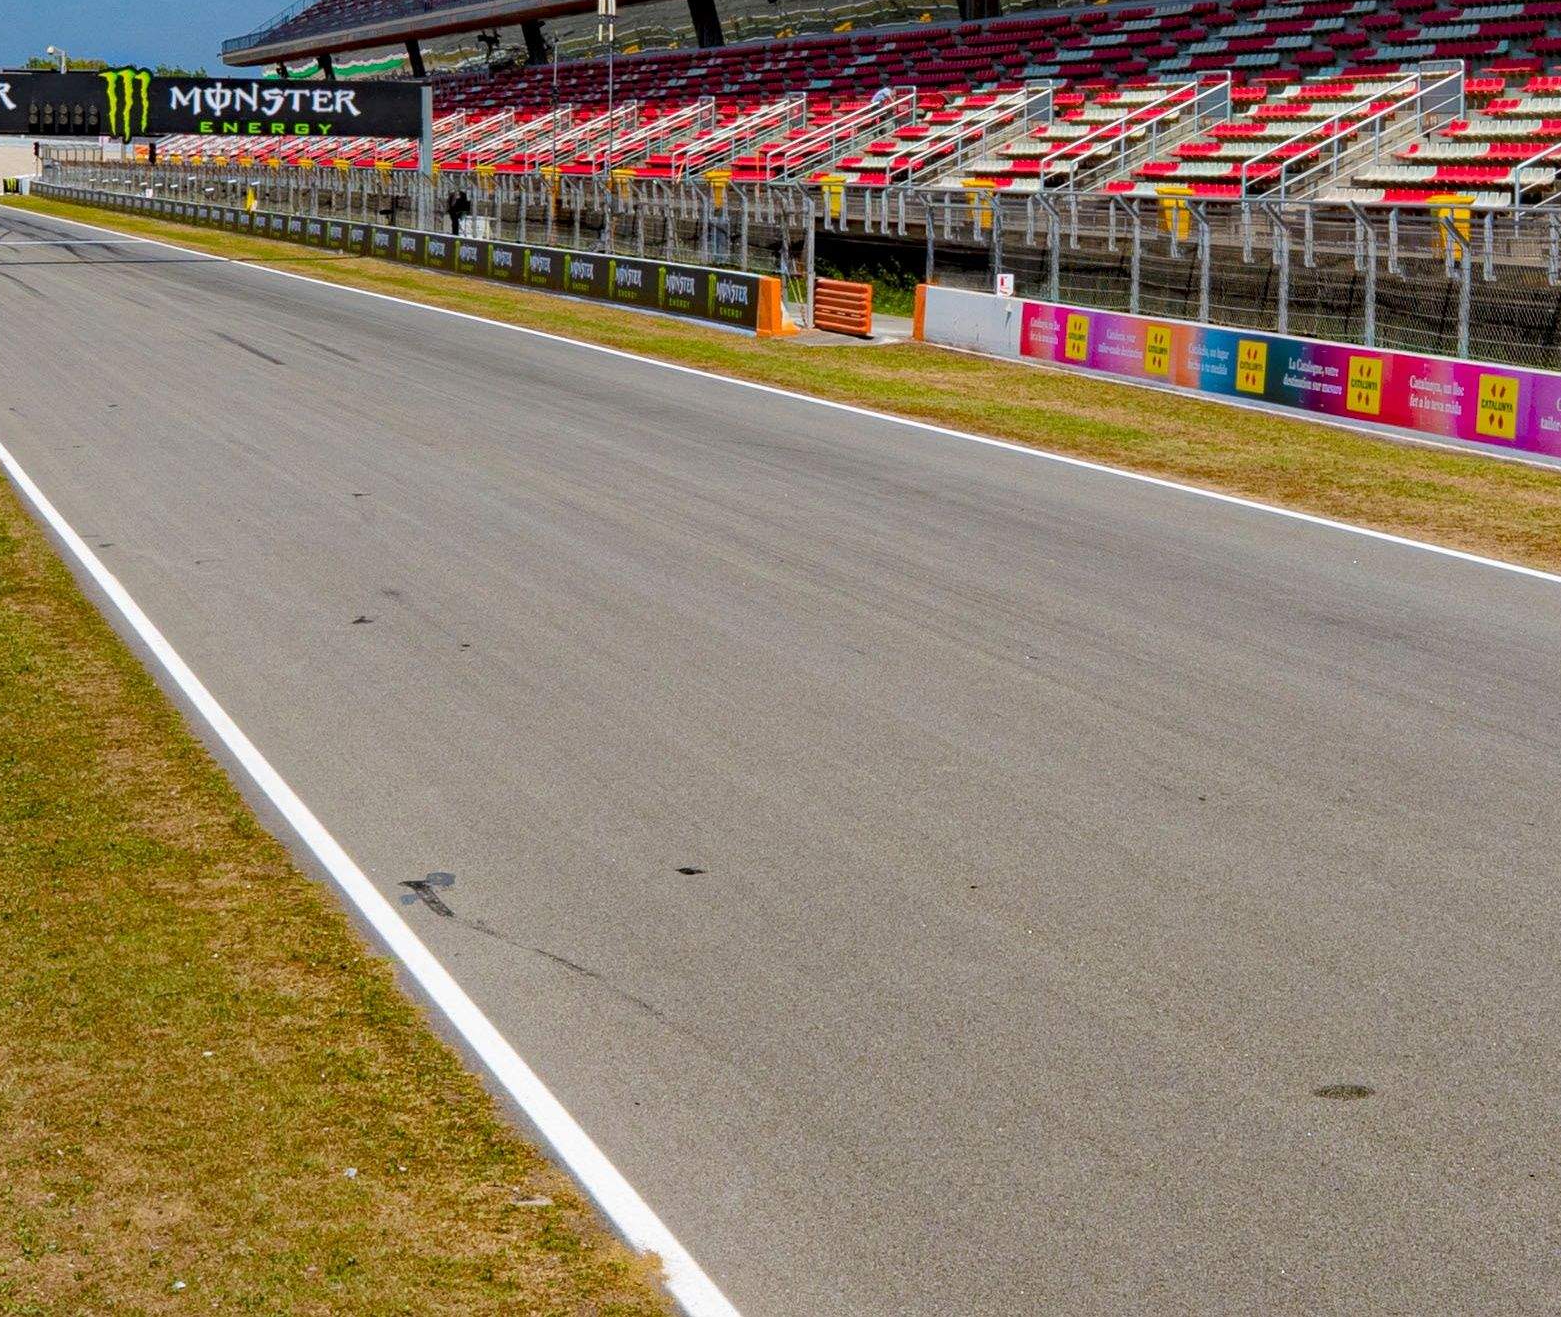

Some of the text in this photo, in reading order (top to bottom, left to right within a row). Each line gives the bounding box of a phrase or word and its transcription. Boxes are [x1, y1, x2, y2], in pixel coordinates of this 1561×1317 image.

[170, 83, 361, 117] MONSTER
[200, 121, 333, 135] ENERGY
[716, 279, 749, 305] MONSTER
[1481, 398, 1513, 413] CATALUNYA
